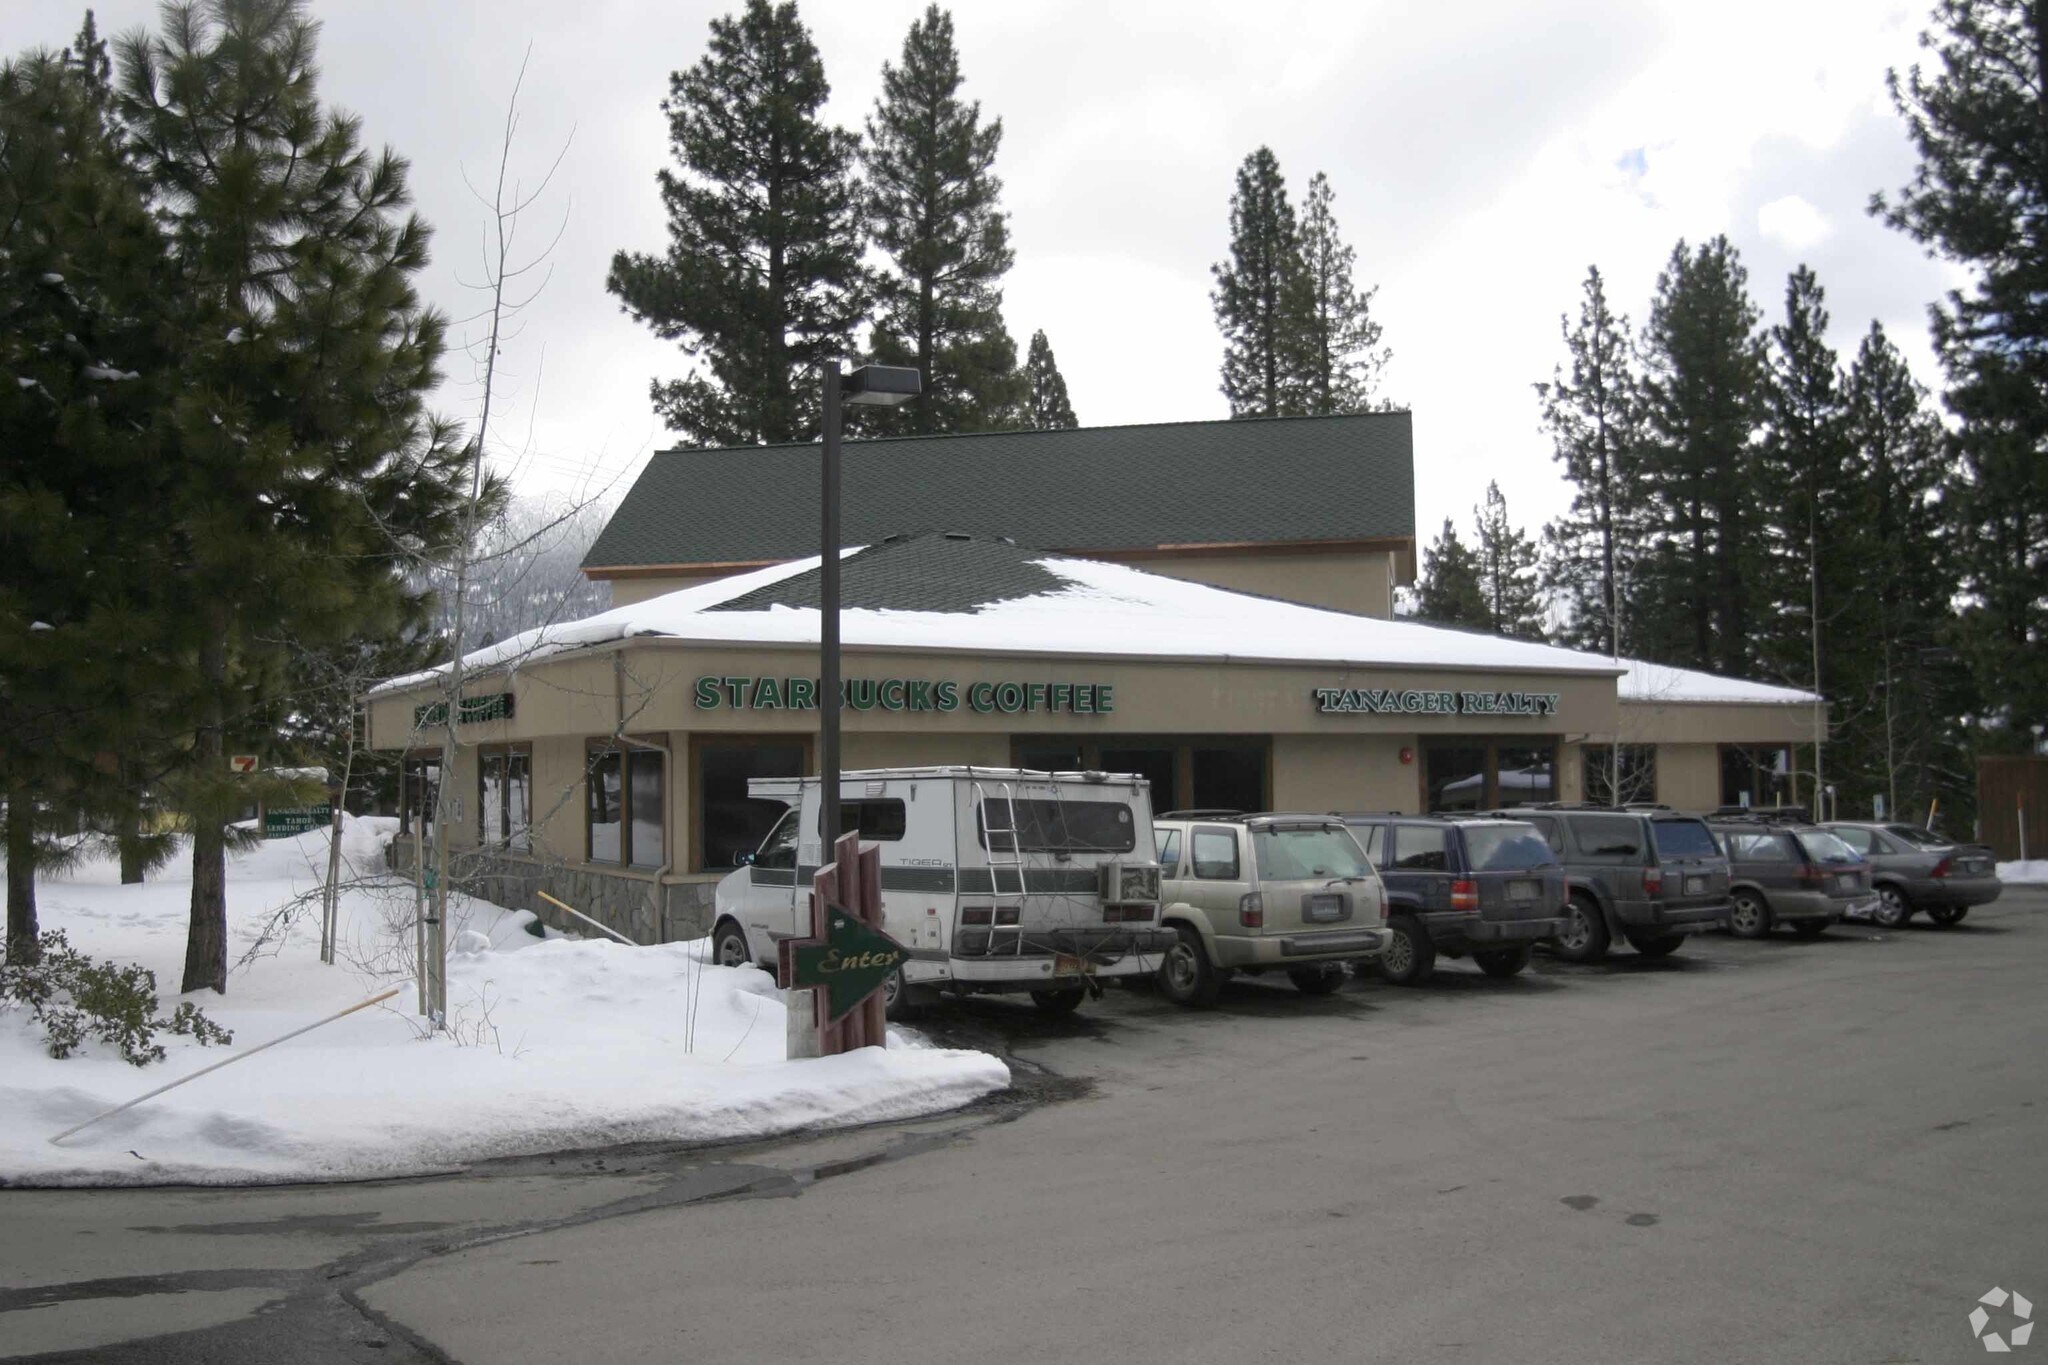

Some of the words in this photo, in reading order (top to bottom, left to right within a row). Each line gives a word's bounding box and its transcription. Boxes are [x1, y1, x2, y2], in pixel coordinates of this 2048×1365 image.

[971, 681, 1114, 714] COFFEE
[1317, 688, 1457, 713] TANAGER
[1461, 691, 1559, 715] REALTY
[818, 948, 899, 974] Enter
